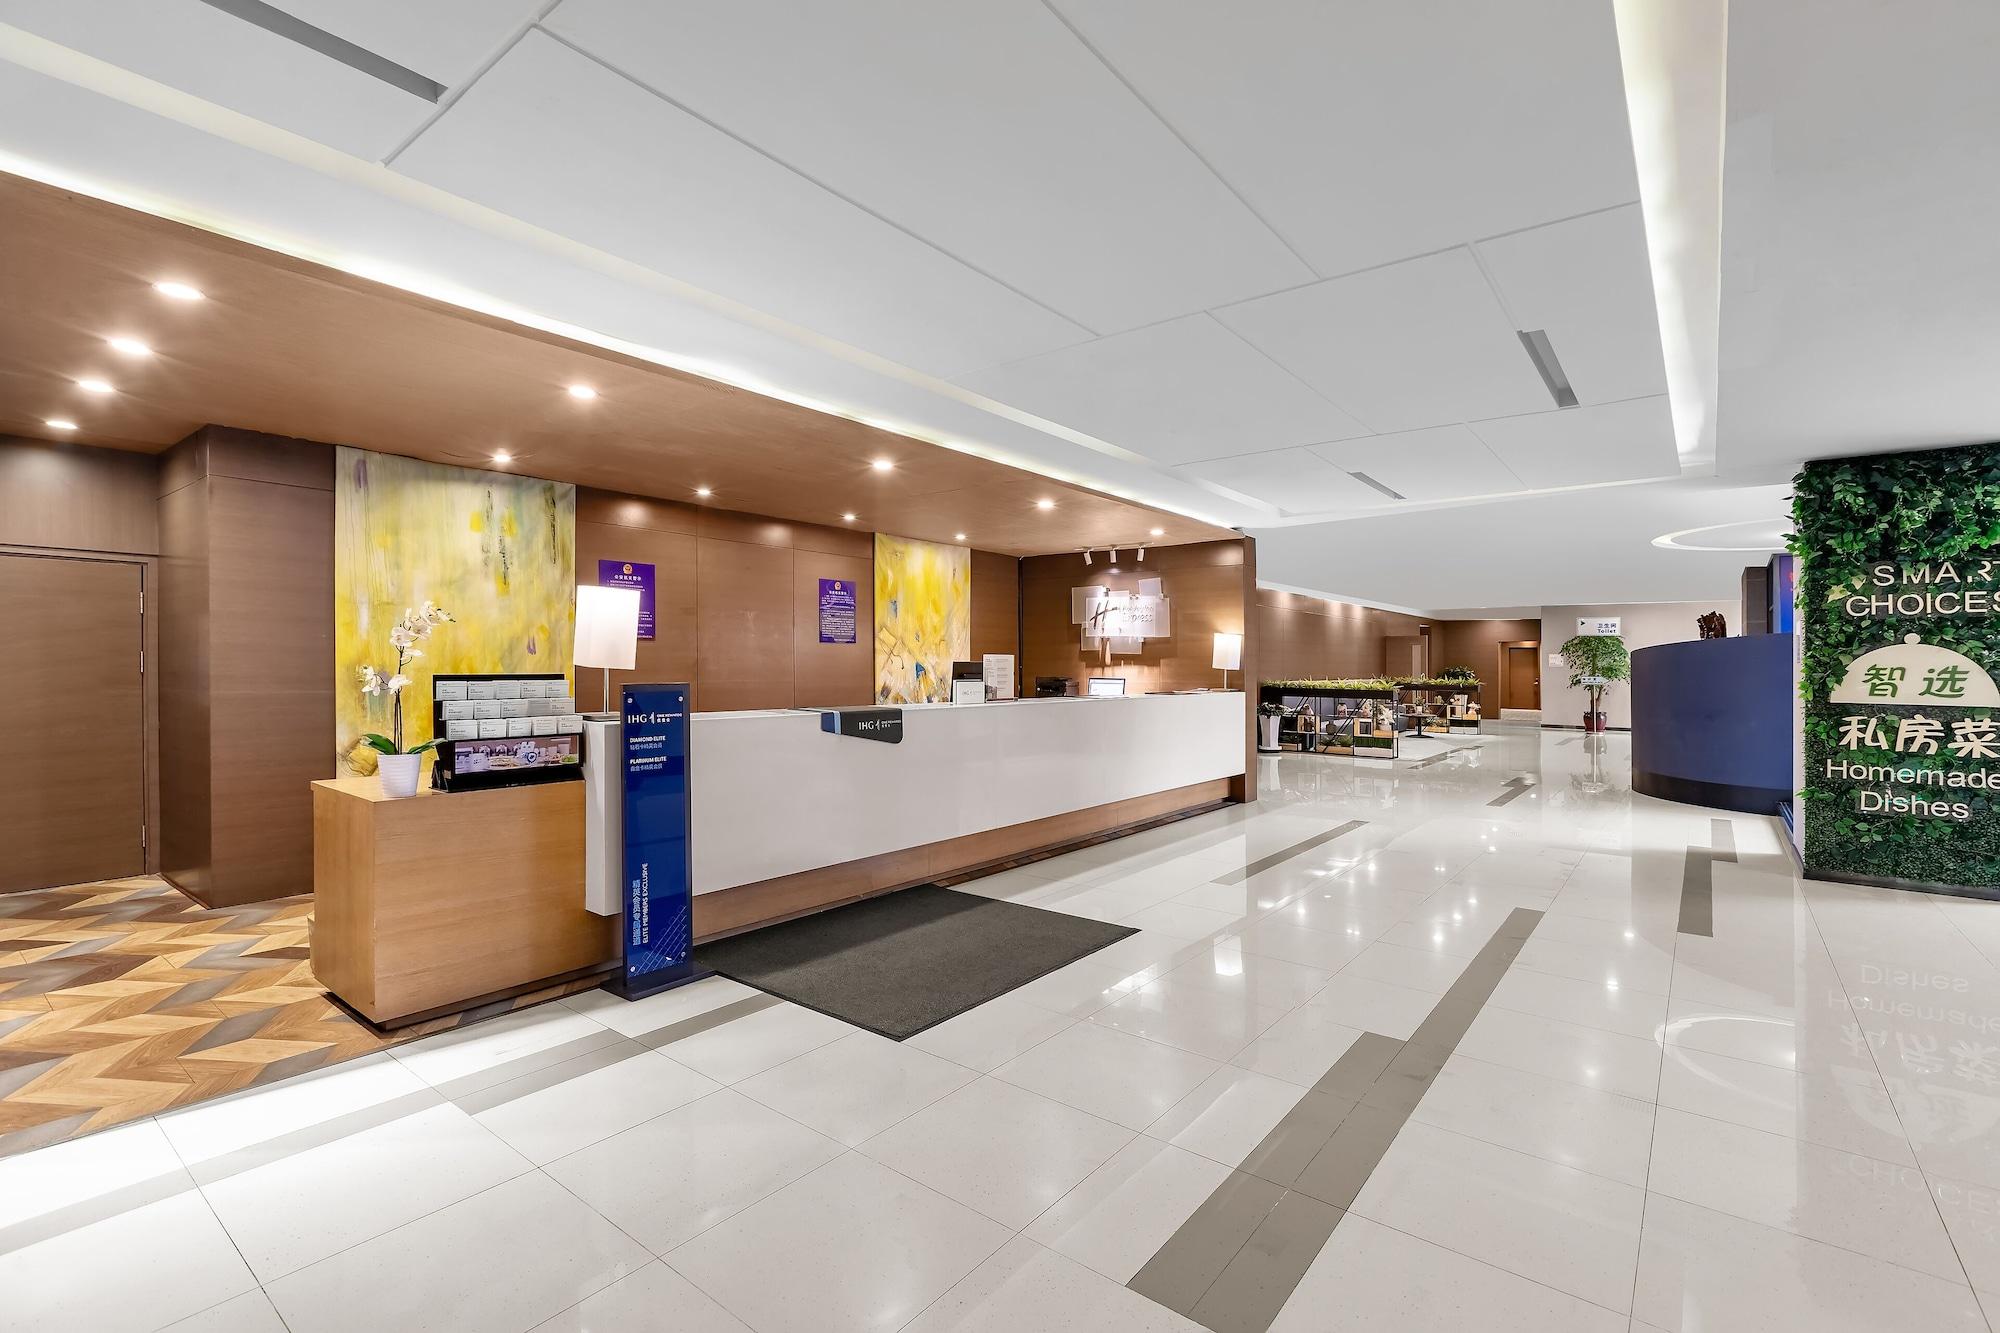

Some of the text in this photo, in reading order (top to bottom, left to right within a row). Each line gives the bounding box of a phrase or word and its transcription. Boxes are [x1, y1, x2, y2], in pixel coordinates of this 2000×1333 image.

[1862, 664, 1970, 698] 智选
[627, 714, 647, 724] IHG
[858, 721, 874, 730] IHG
[1838, 714, 2000, 758] 私房菜
[654, 755, 667, 763] ELITE
[1826, 758, 2000, 790] Homemade
[1860, 790, 1970, 819] Dishes
